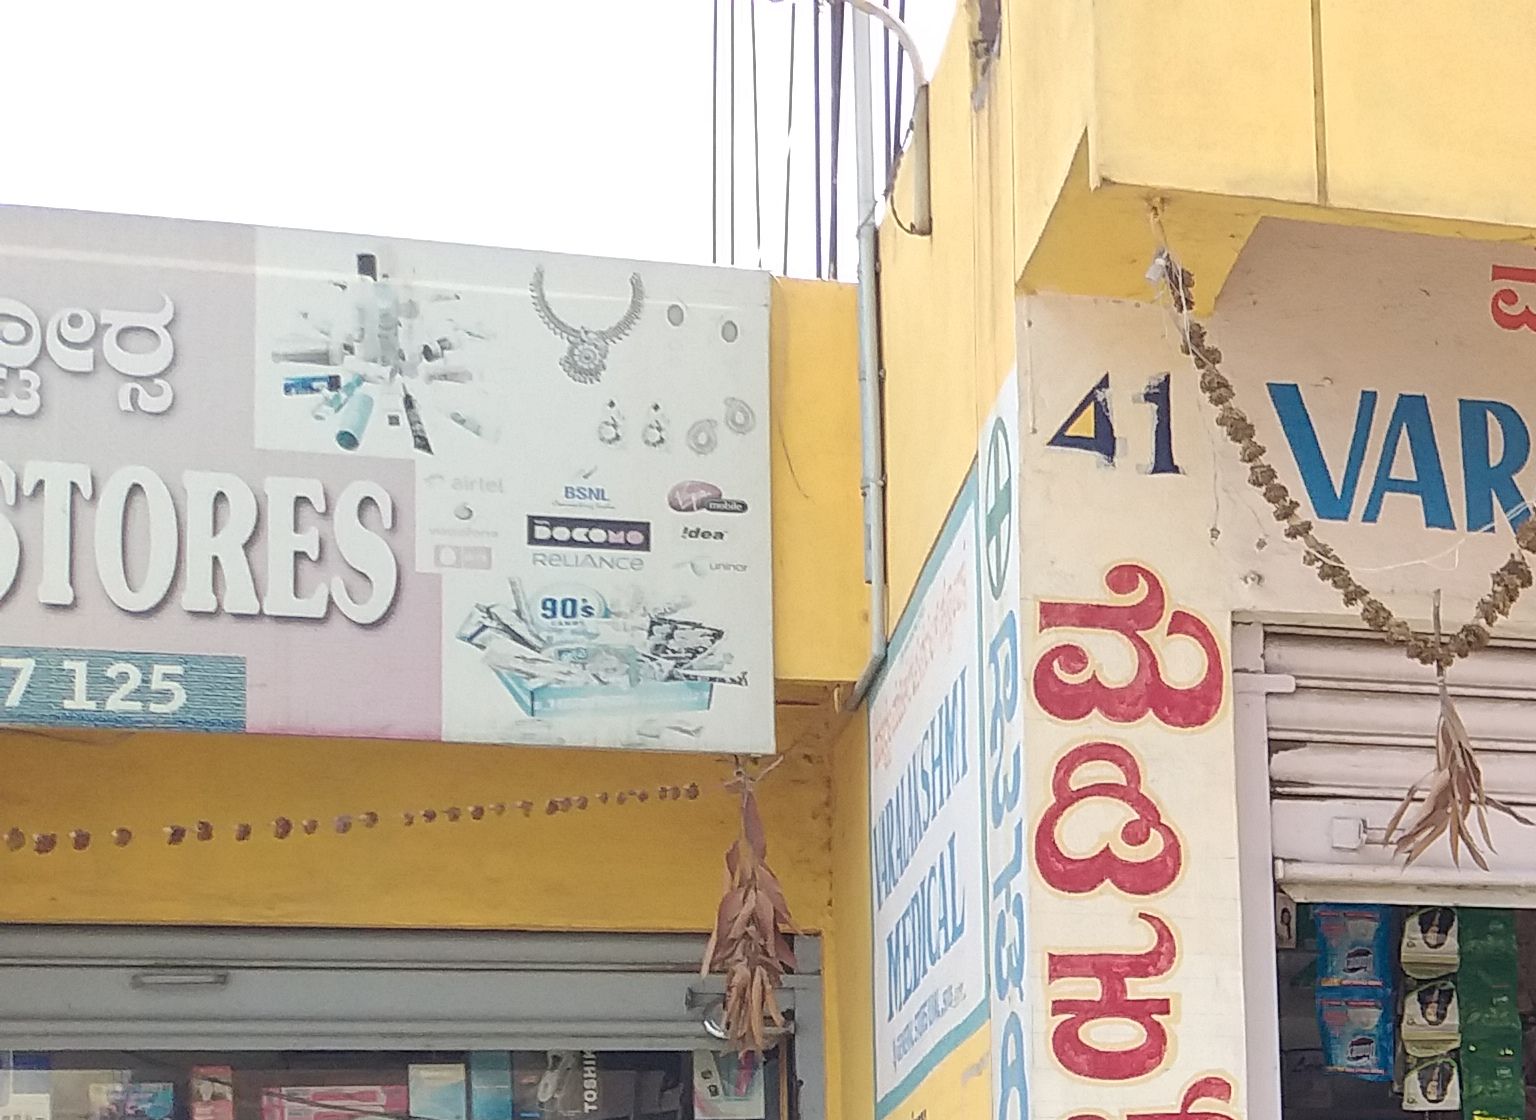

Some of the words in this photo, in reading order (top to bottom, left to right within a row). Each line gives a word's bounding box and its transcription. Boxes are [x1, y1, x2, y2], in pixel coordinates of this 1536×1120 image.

[1046, 371, 1184, 475] 41
[564, 485, 611, 502] BSNL
[540, 597, 596, 620] 90's
[63, 660, 188, 714] 125
[873, 664, 968, 913] VARALAKSHMI
[886, 832, 966, 1024] MEDICAL
